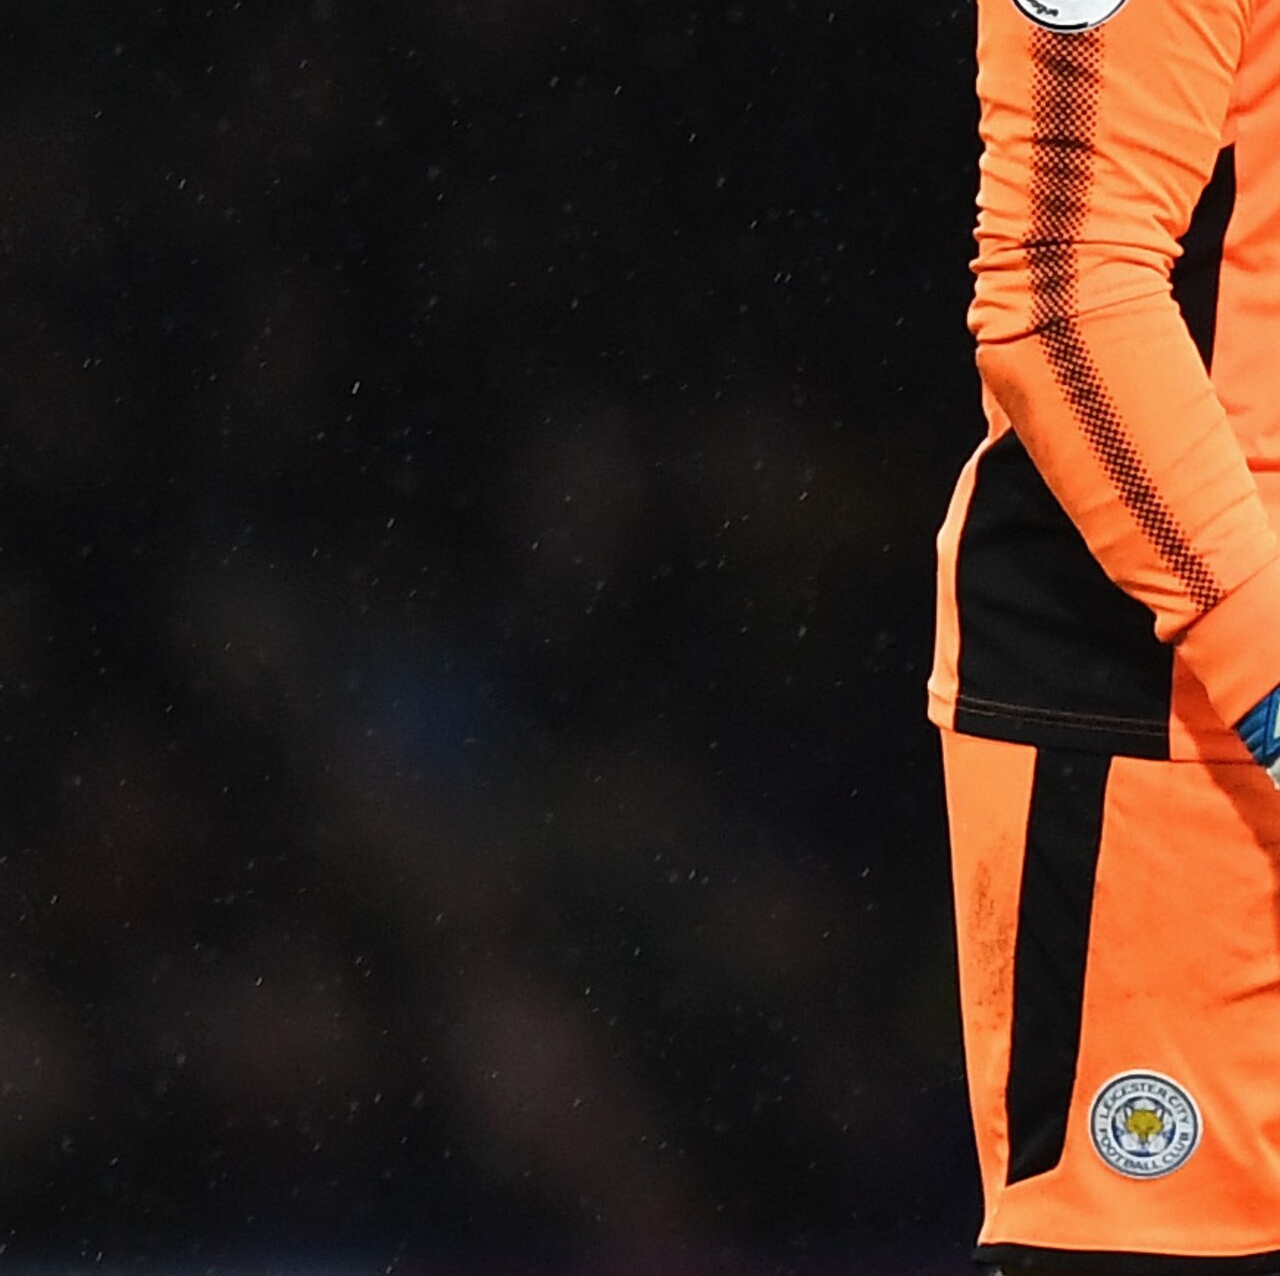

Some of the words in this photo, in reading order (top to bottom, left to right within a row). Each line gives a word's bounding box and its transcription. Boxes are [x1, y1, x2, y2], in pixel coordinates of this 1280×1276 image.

[1100, 1082, 1168, 1120] LEICESTER
[1168, 1095, 1190, 1124] CITY
[1098, 1128, 1161, 1171] FOOTBALL
[1162, 1131, 1190, 1165] CLUB
